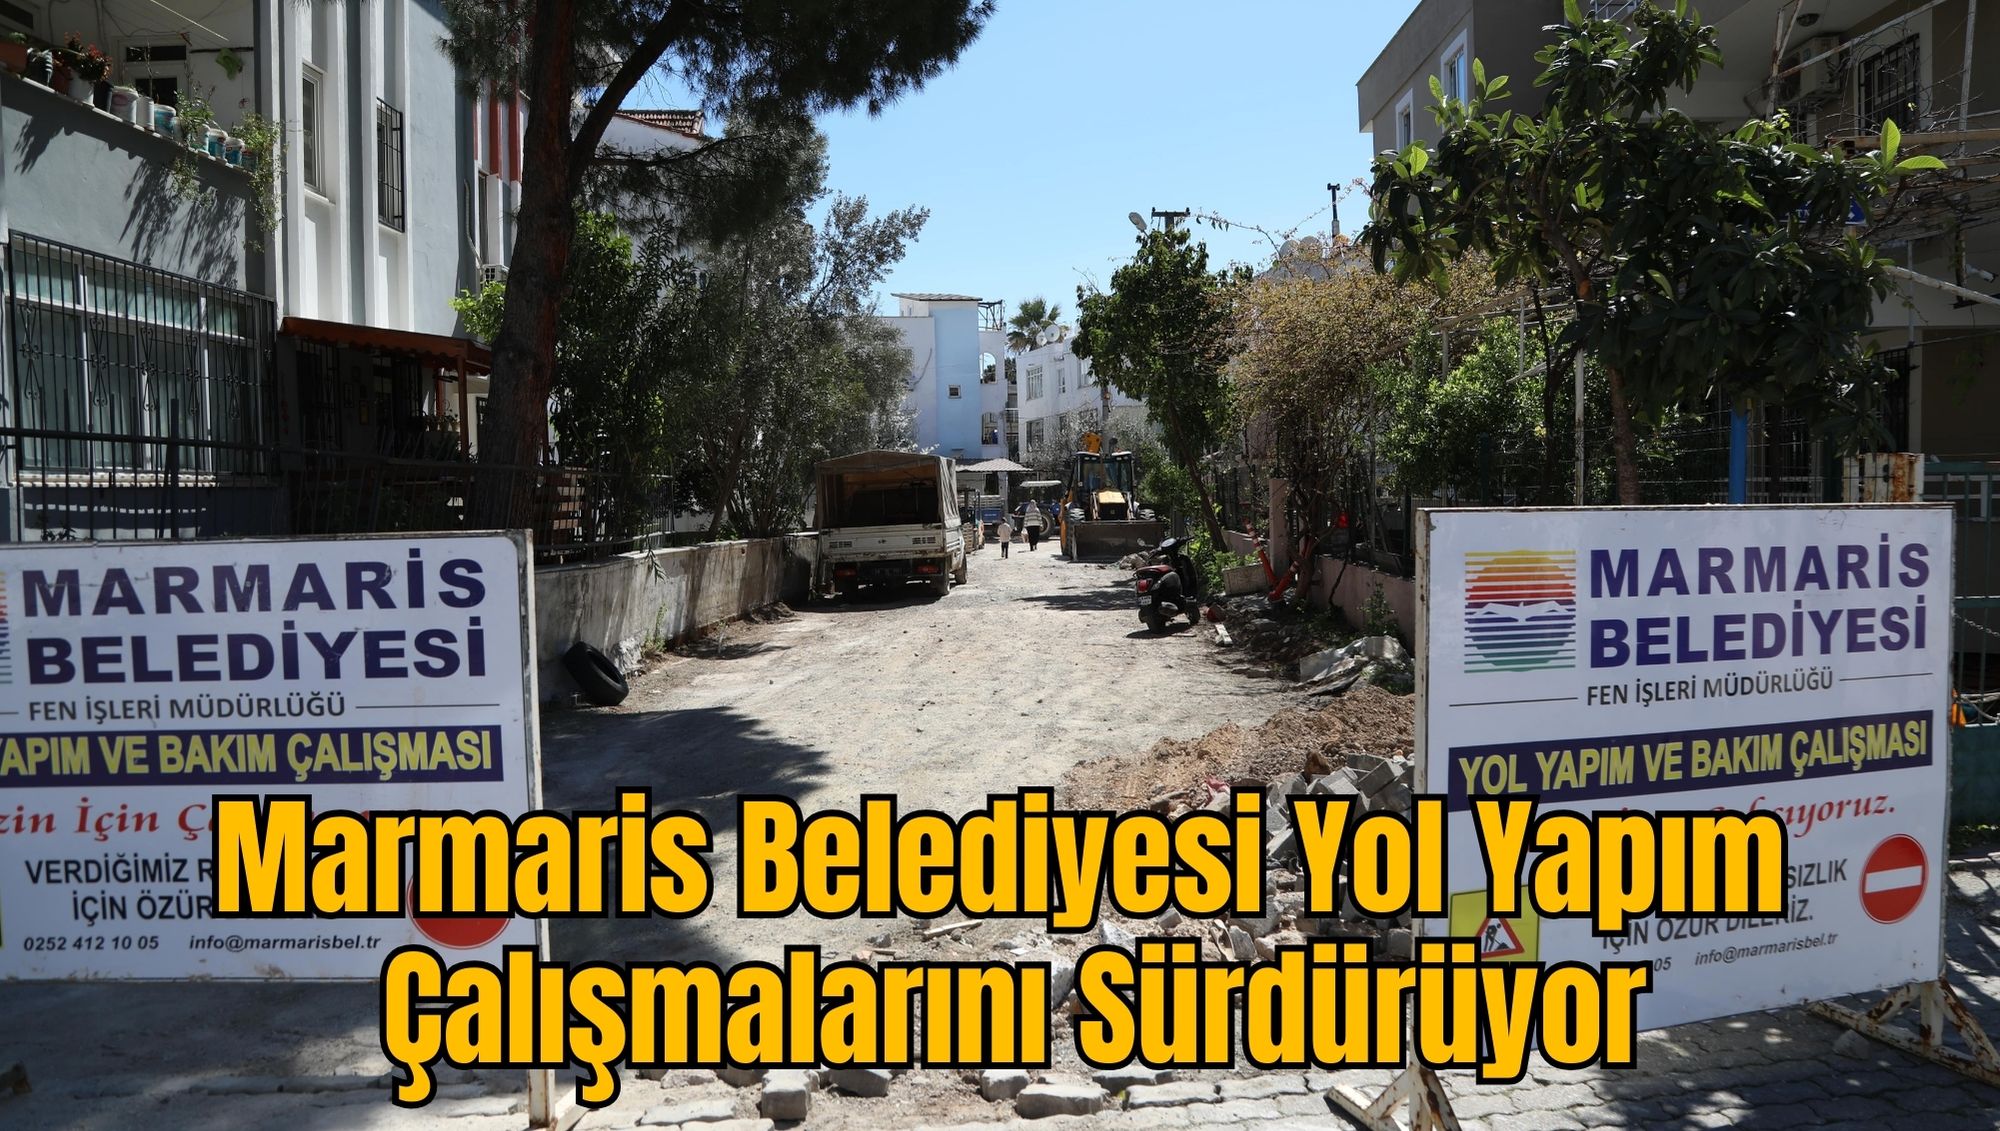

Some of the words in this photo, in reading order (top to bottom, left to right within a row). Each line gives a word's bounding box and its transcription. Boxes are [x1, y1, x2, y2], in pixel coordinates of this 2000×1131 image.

[22, 547, 487, 618] MARMARİS
[1589, 533, 1930, 599] MARMARİS
[26, 615, 487, 685] BELEDİYESİ
[1589, 594, 1927, 669] BELEDİYESİ
[28, 700, 77, 722] FEN
[85, 694, 161, 725] İŞLERİ
[169, 690, 346, 720] MÜDÜRLÜĞÜ
[1587, 684, 1628, 706] FEN
[1635, 675, 1697, 707] İŞLERİ
[1703, 666, 1833, 698] MÜDÜRLÜĞÜ
[0, 736, 91, 776] APIM
[98, 735, 149, 775] VE
[158, 733, 277, 774] BAKIM
[286, 729, 492, 782] ÇALIŞMASI
[1458, 754, 1528, 795] YOL
[1535, 745, 1635, 791] YAPIM
[1642, 741, 1684, 782] VE
[1691, 733, 1783, 778] BAKIM
[1789, 719, 1927, 778] ÇALIŞMASI
[74, 796, 160, 841] İçin
[24, 852, 190, 884] VERDİĞİMİZ
[72, 889, 128, 927] İÇİN
[24, 937, 67, 951] 0252
[72, 936, 105, 950] 412
[111, 935, 132, 950] 10
[138, 935, 159, 950] 05
[189, 934, 381, 953] info@marmarisbel.tr
[1694, 932, 1839, 966] info@marmarisbel.tr
